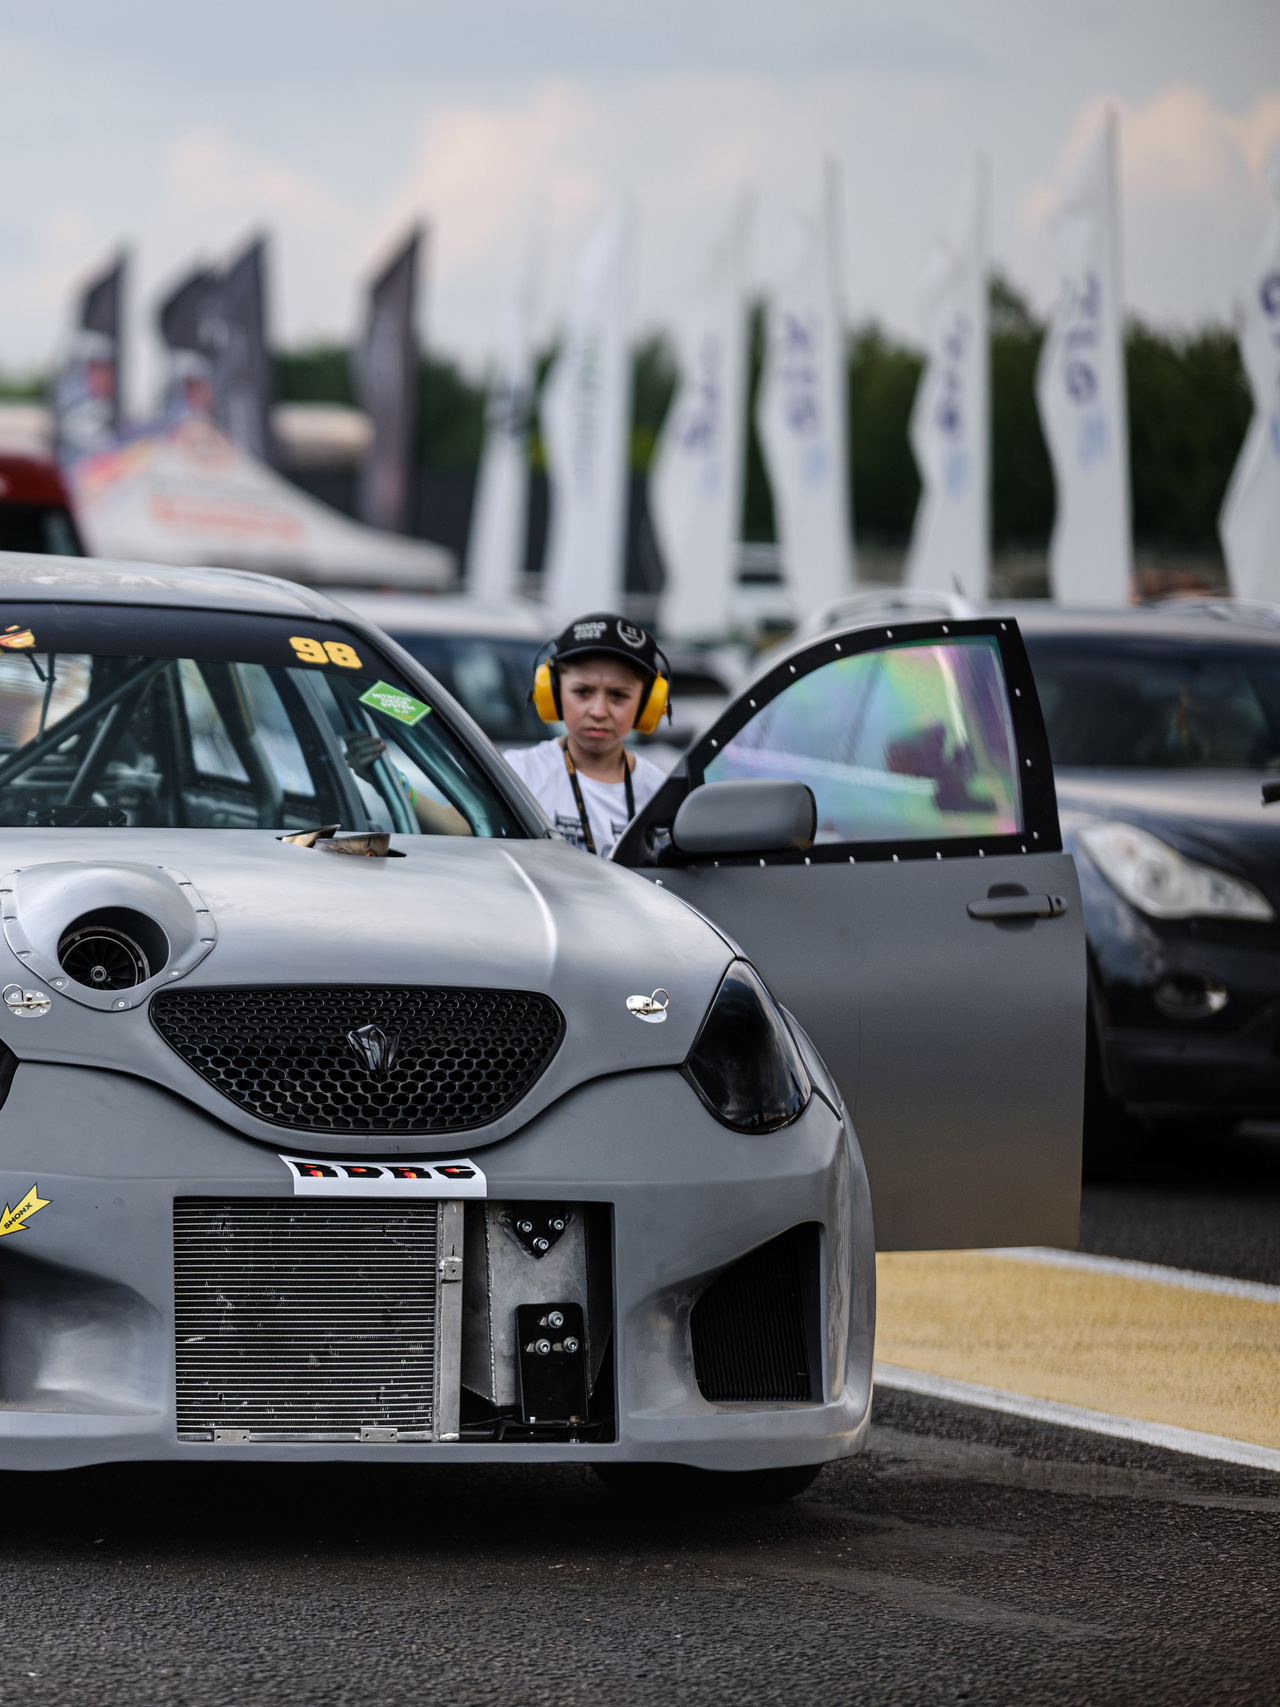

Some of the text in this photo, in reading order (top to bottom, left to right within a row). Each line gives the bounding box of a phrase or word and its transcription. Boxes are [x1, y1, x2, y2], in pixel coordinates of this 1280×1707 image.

[289, 636, 363, 669] 98
[288, 1160, 476, 1180] RDRC
[3, 1202, 33, 1229] SHONX
